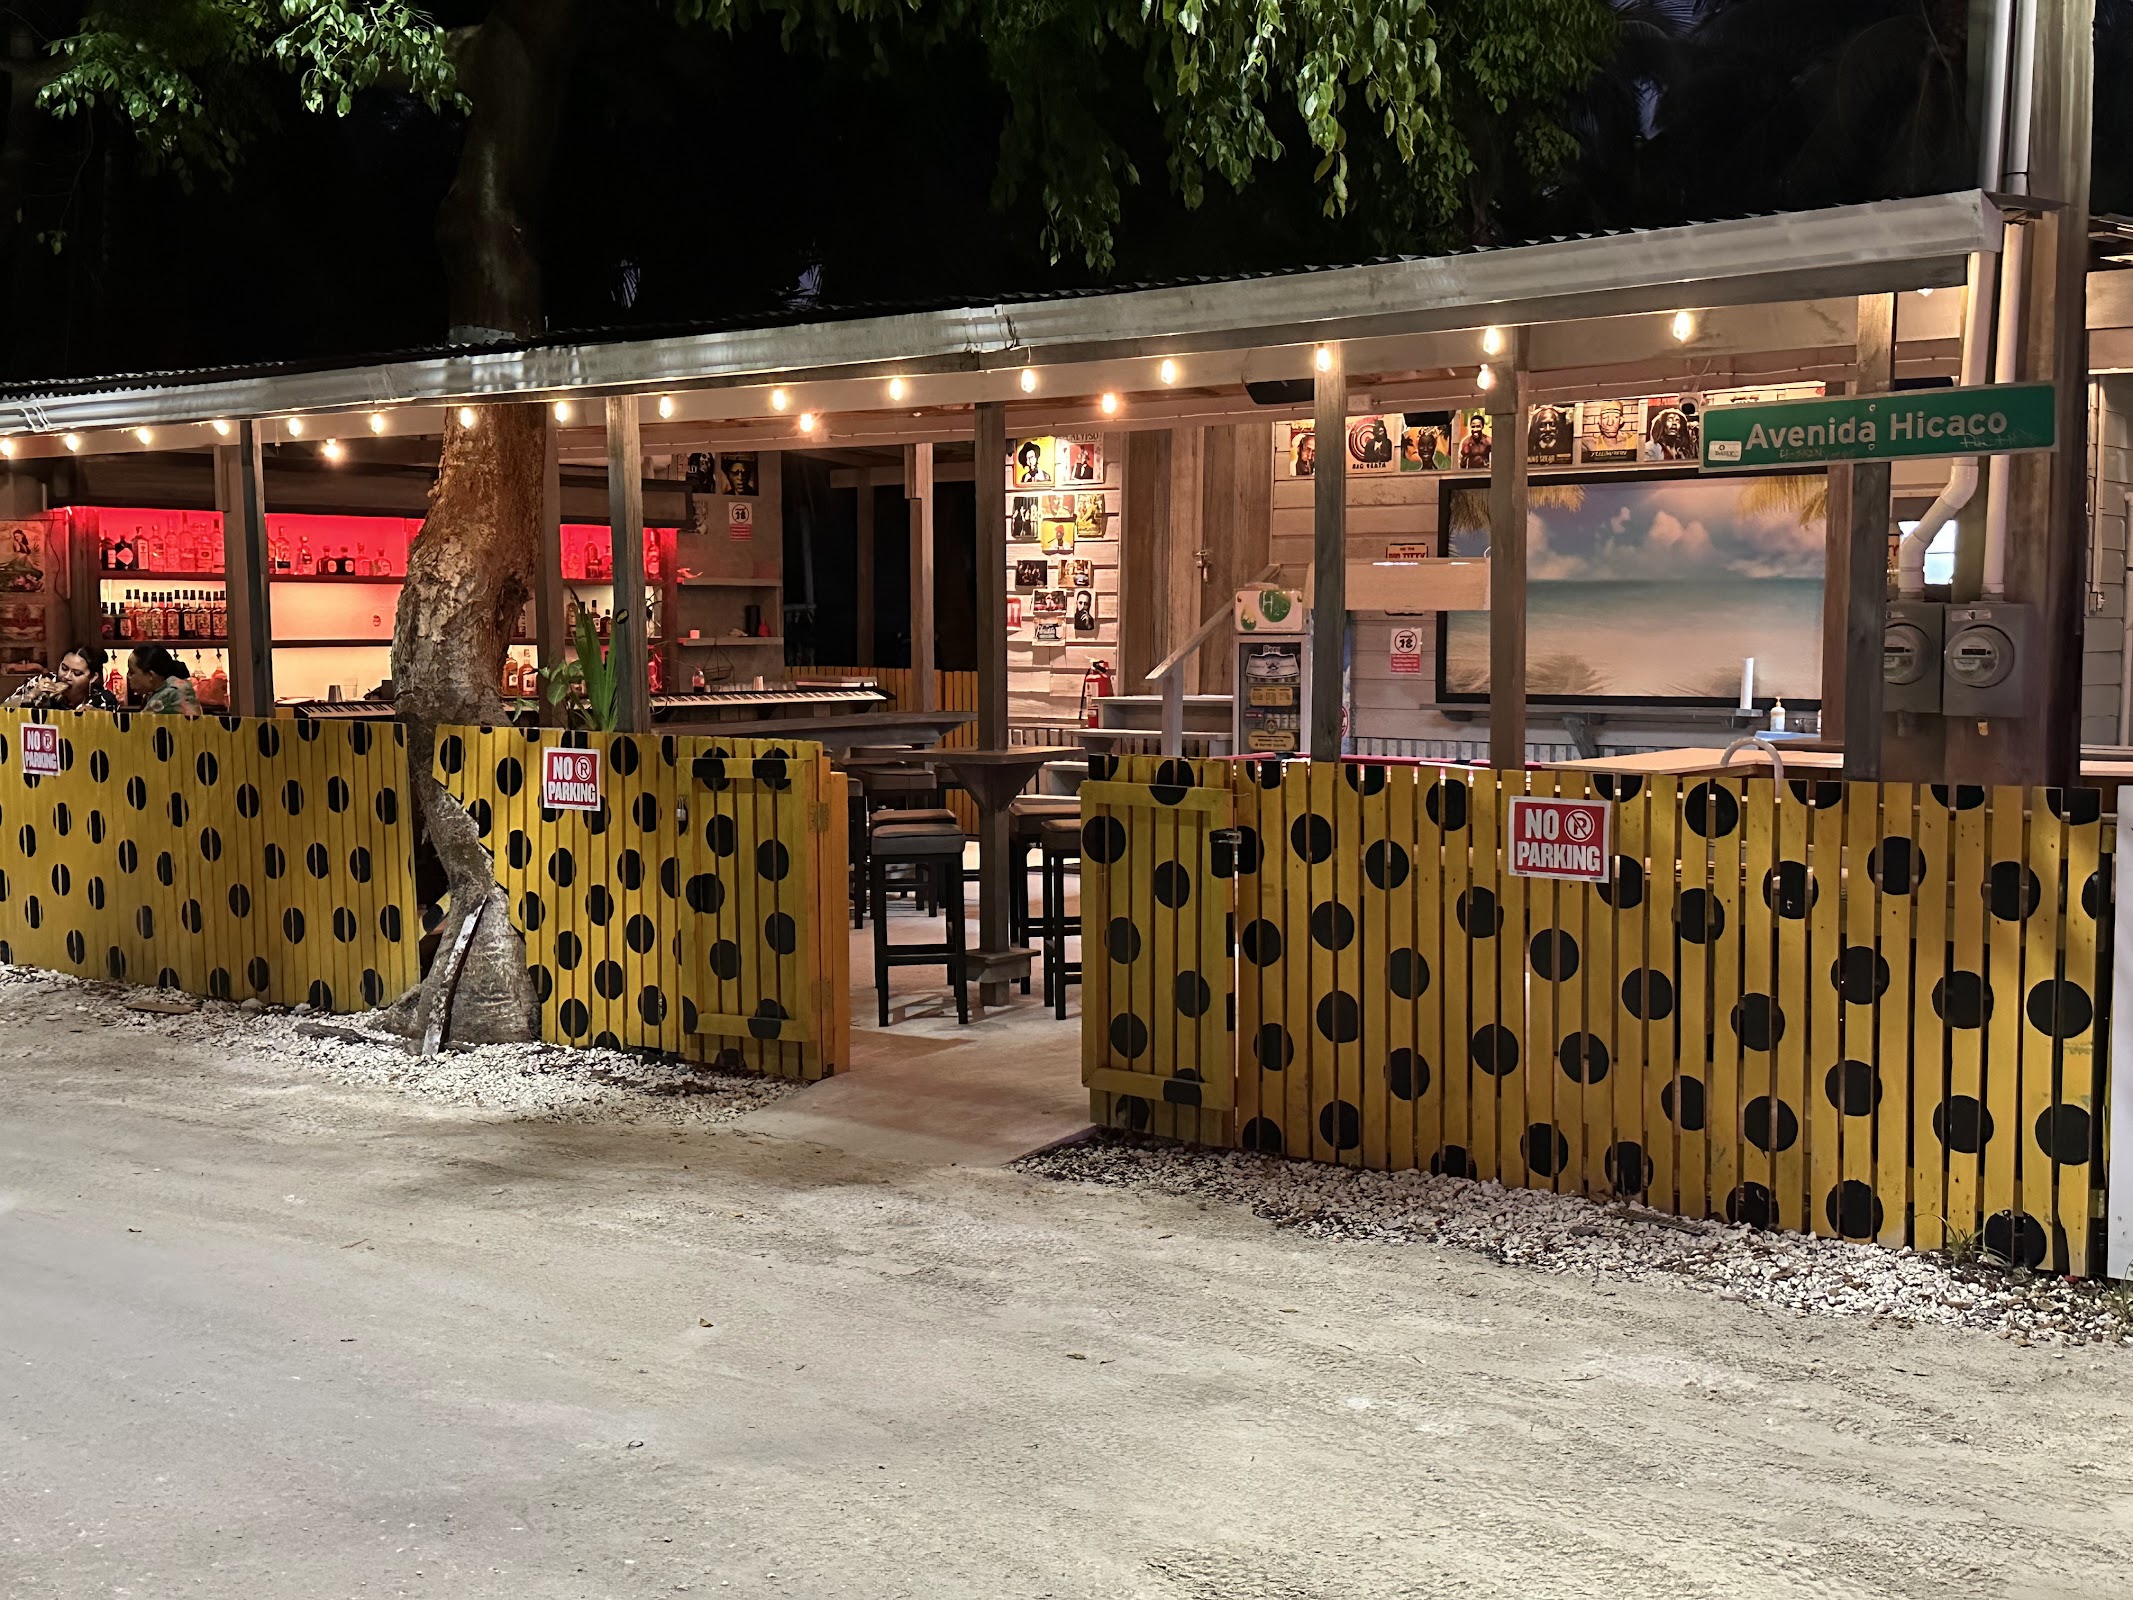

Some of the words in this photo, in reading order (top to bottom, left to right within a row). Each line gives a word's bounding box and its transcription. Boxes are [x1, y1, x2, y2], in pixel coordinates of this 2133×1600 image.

[1745, 416, 1876, 450] Avenida
[1890, 411, 2007, 441] Hicaco
[1399, 638, 1413, 648] 18
[27, 730, 41, 751] NO
[25, 751, 58, 769] PARKING
[553, 756, 573, 780] NO
[548, 781, 596, 803] PARKING
[1525, 808, 1560, 840] NO
[1516, 841, 1601, 872] PARKING
